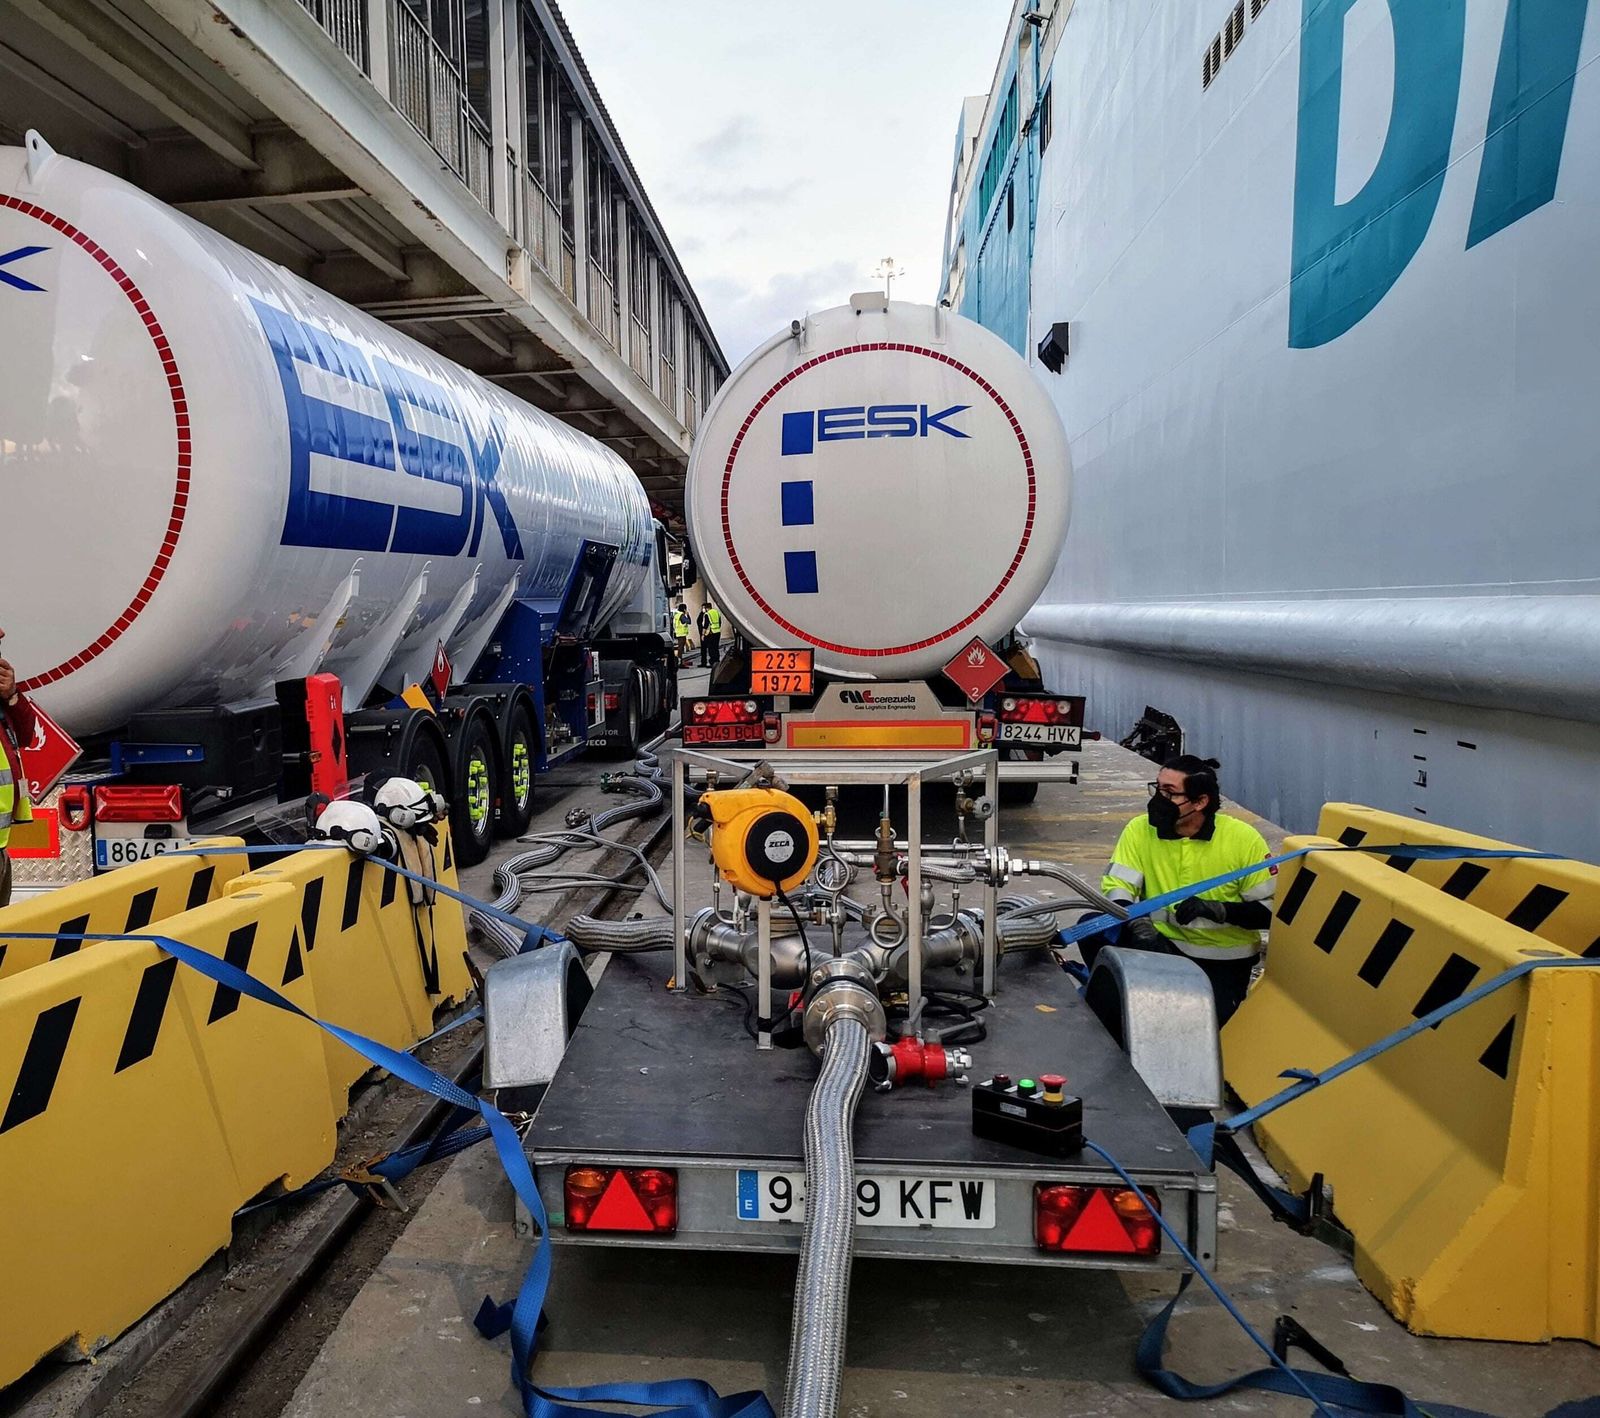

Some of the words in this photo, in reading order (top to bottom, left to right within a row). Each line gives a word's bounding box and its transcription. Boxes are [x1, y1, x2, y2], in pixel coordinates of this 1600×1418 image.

[247, 293, 525, 560] ESK
[818, 404, 972, 442] ESK
[765, 653, 796, 670] 223
[761, 675, 802, 692] 1972
[971, 687, 979, 697] 2
[685, 727, 693, 741] R
[697, 726, 730, 741] 5049
[1004, 725, 1041, 740] 8244
[1047, 727, 1076, 742] HVK
[31, 781, 40, 794] 2
[769, 840, 790, 848] ZECA
[768, 1175, 881, 1218] 99
[899, 1179, 984, 1220] KFW
